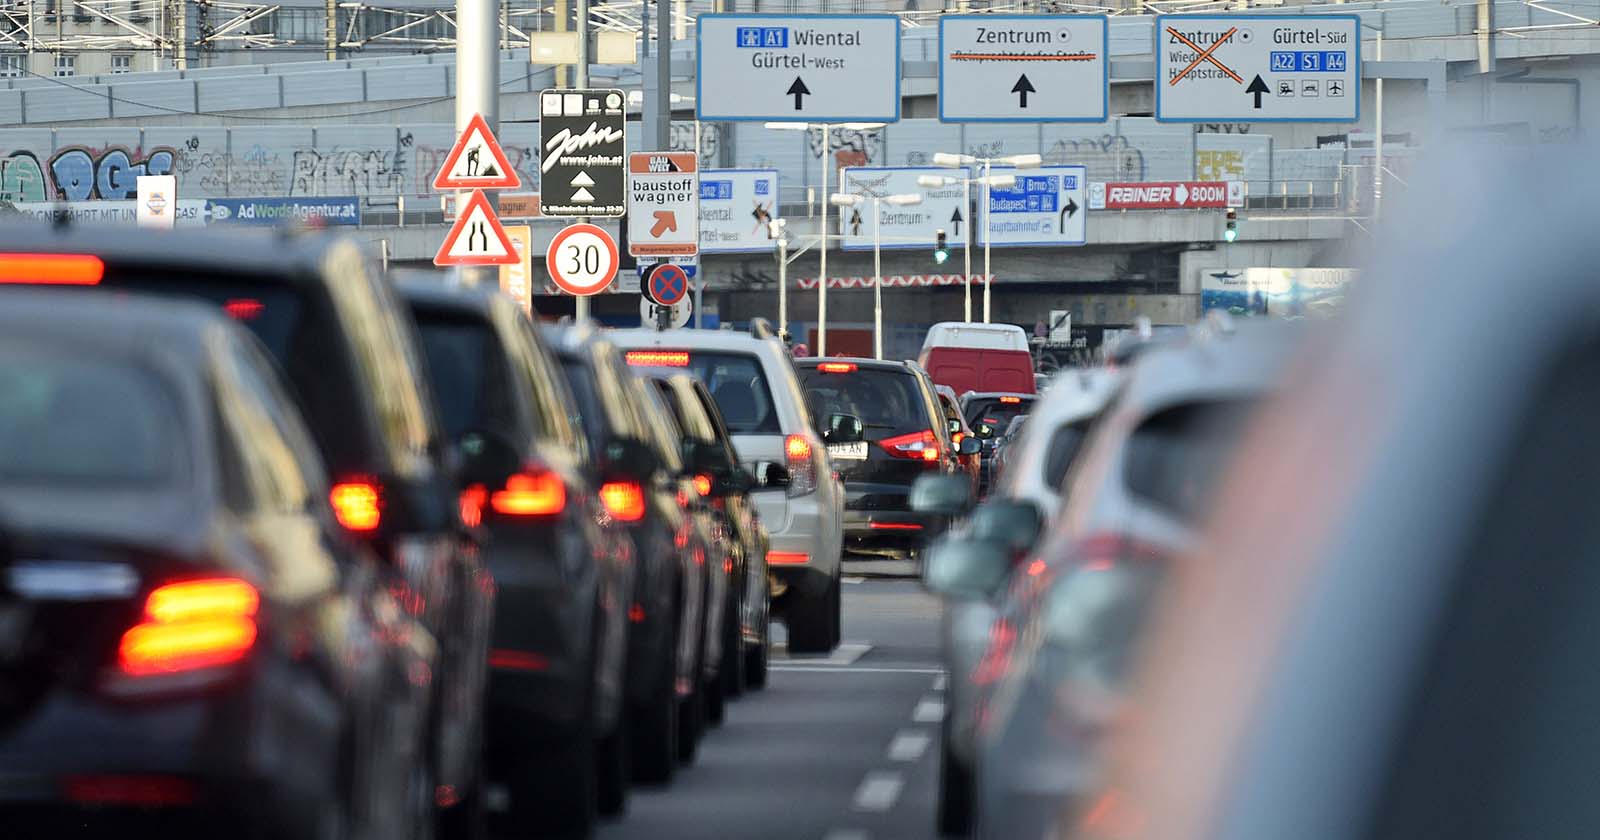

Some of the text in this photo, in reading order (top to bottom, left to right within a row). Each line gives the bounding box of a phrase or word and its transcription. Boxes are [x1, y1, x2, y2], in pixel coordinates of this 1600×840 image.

[767, 30, 861, 45] A1 Wiental
[976, 28, 1052, 44] Zentrum
[1274, 54, 1344, 69] A22 S1 A4
[541, 121, 623, 174] John
[560, 155, 623, 168] www.john.at
[649, 156, 668, 164] BAU
[649, 164, 670, 173] WELT
[633, 180, 692, 191] baustoff
[634, 193, 693, 204] wagner
[1190, 186, 1225, 202] 800M
[100, 208, 119, 221] MIT
[122, 208, 137, 221] UN
[237, 203, 356, 221] AdWordsAgentur.at
[566, 244, 600, 275] 30
